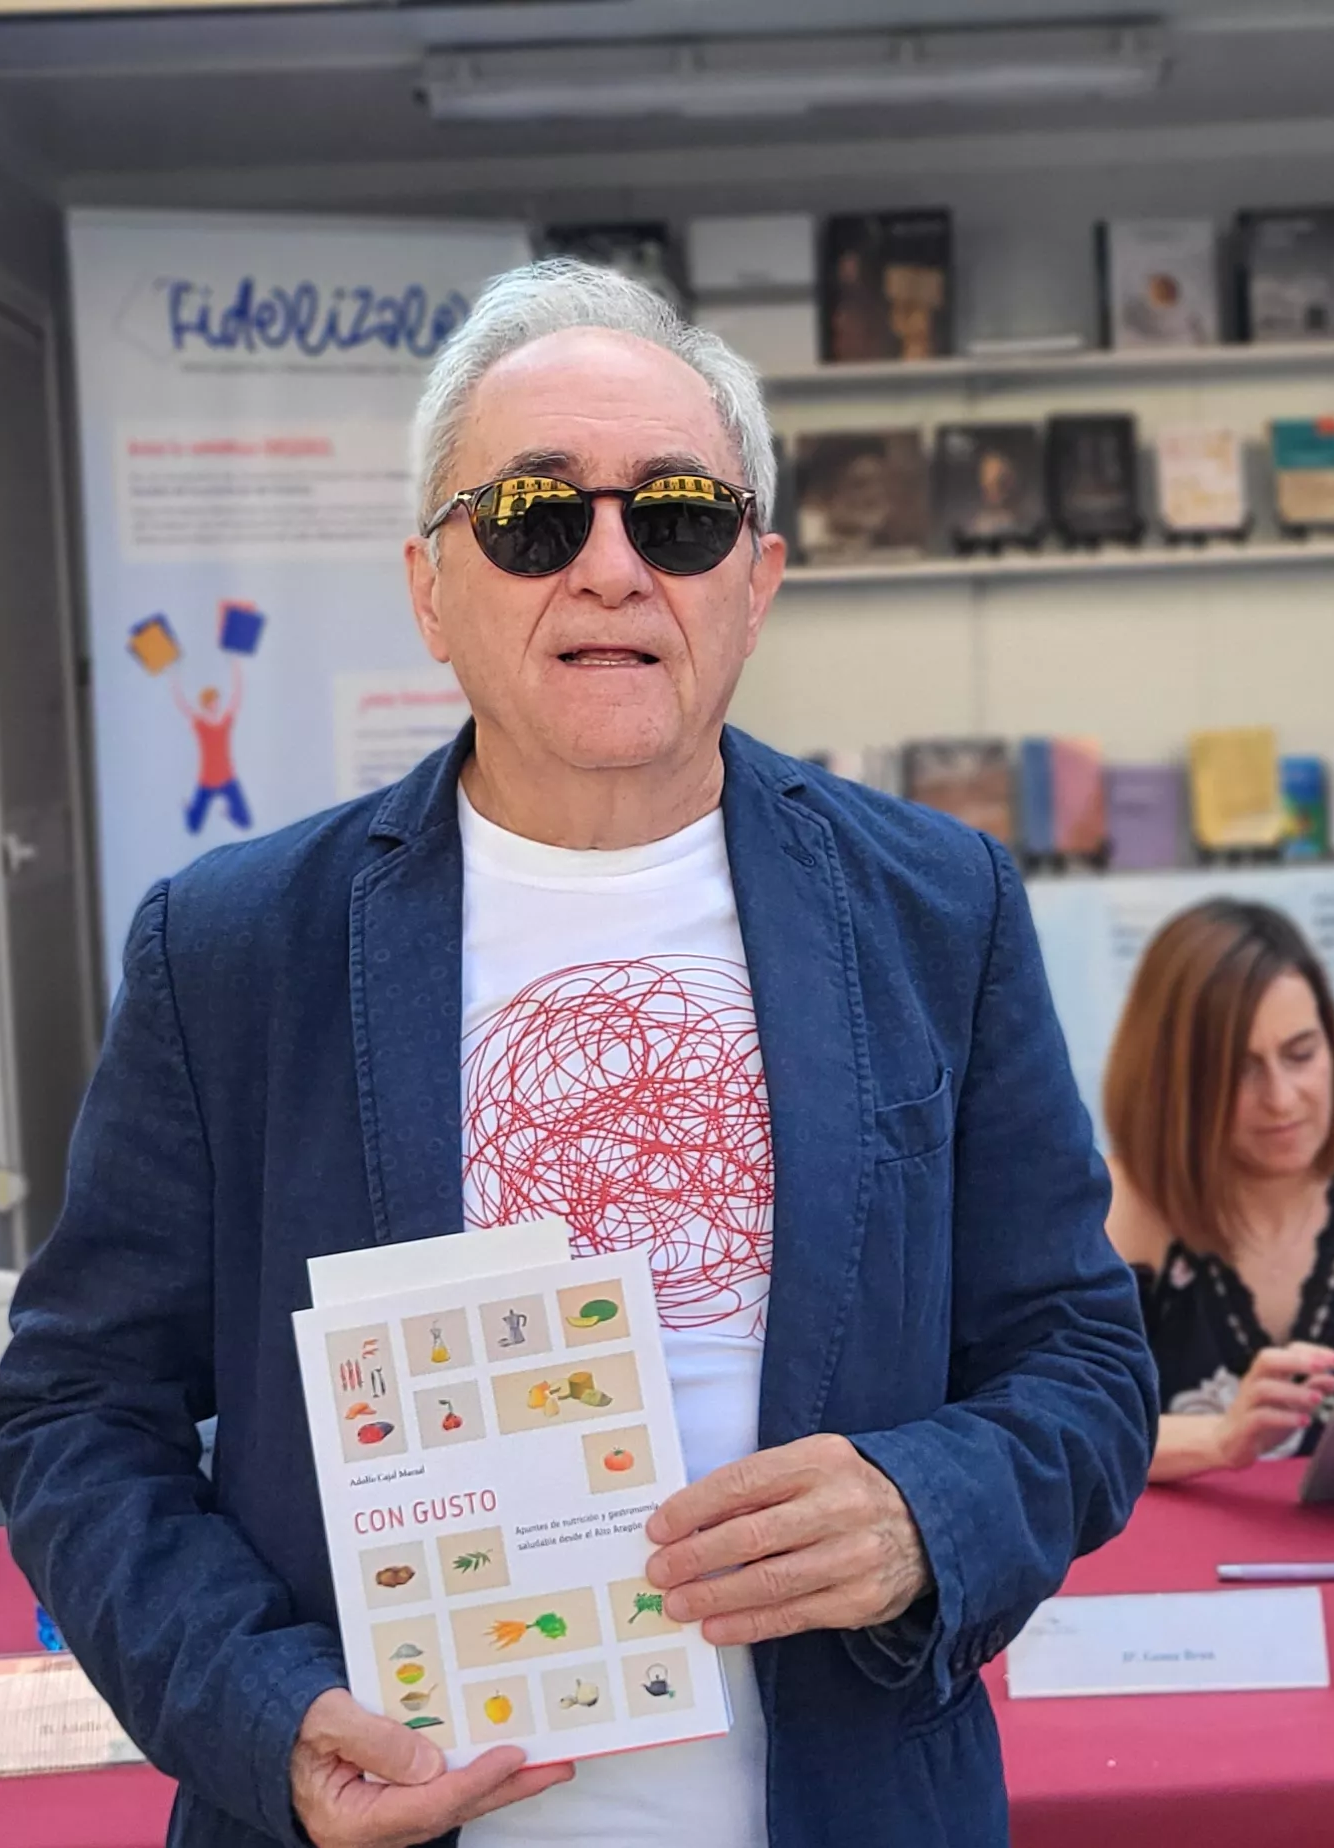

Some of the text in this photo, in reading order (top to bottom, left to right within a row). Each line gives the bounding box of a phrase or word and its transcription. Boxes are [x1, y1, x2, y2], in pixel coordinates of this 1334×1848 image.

[354, 1489, 498, 1535] CON GUSTO
[515, 1523, 549, 1535] Apuntes
[551, 1519, 560, 1529] de
[562, 1513, 600, 1527] nutrición
[517, 1521, 643, 1551] saludable desde el Alto Aragón
